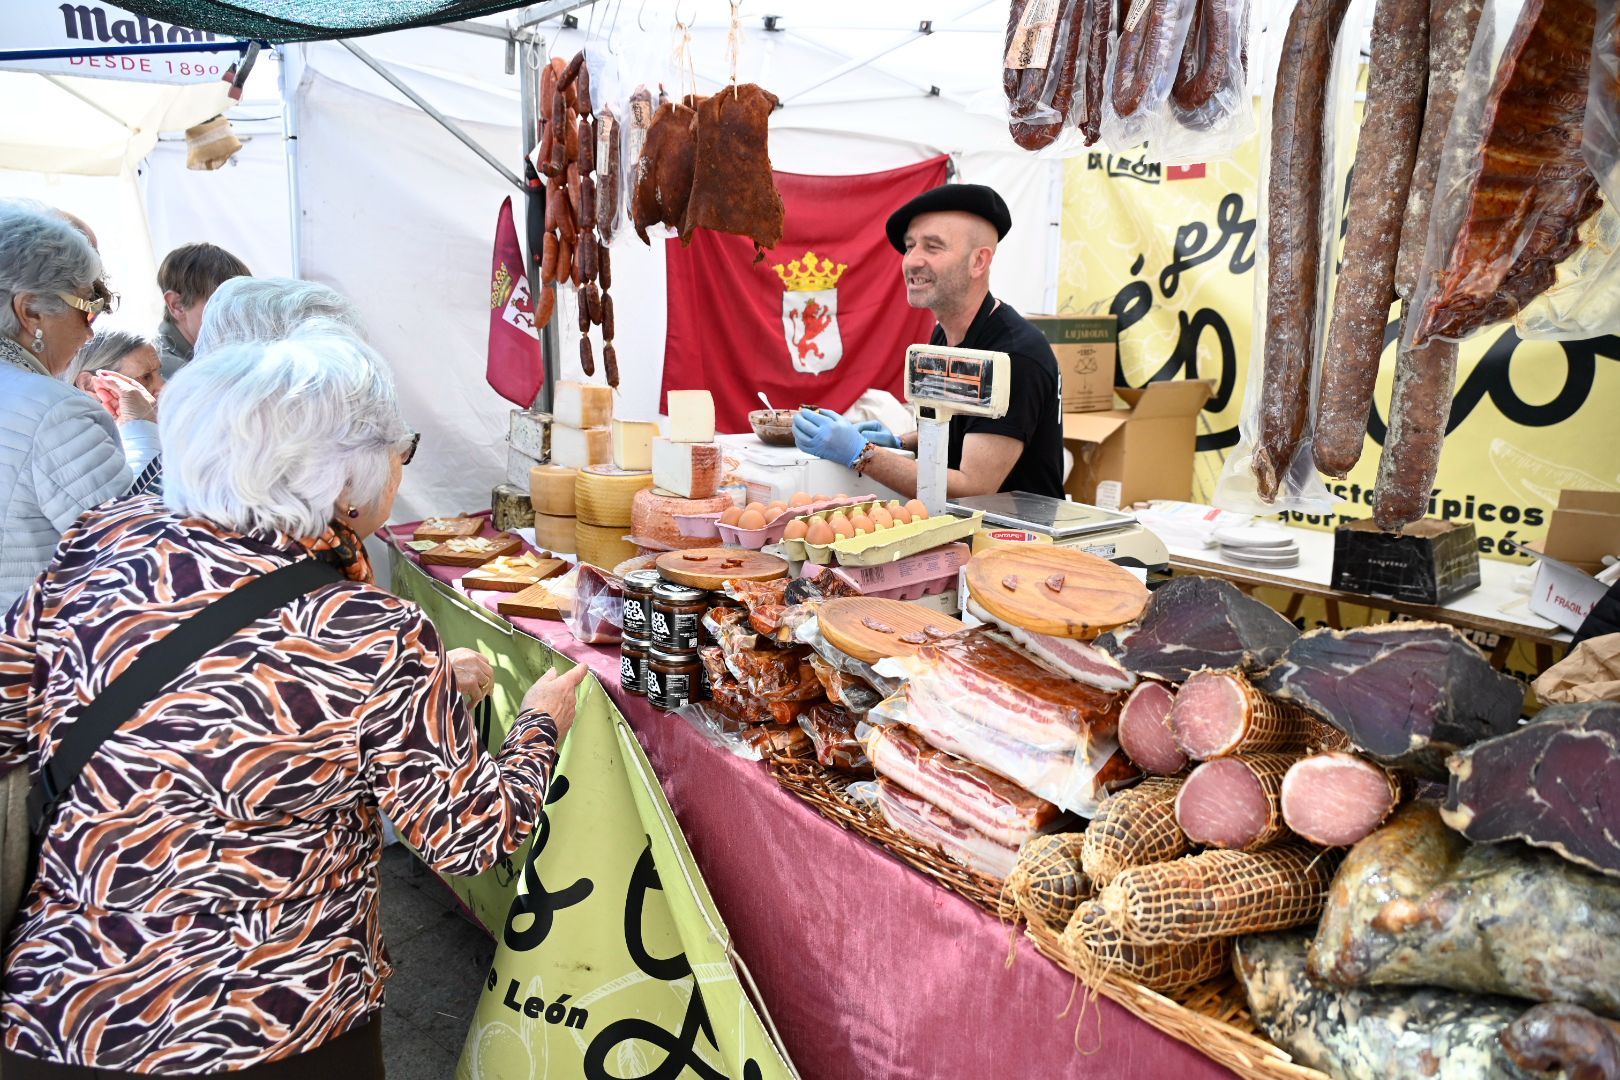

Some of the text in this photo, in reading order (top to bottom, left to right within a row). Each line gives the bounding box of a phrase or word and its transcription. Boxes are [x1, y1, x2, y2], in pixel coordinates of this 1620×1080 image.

[69, 56, 220, 77] DESDE 1890
[1427, 489, 1544, 526] ípicos
[1554, 595, 1587, 617] FRAGIL
[503, 978, 589, 1030] León
